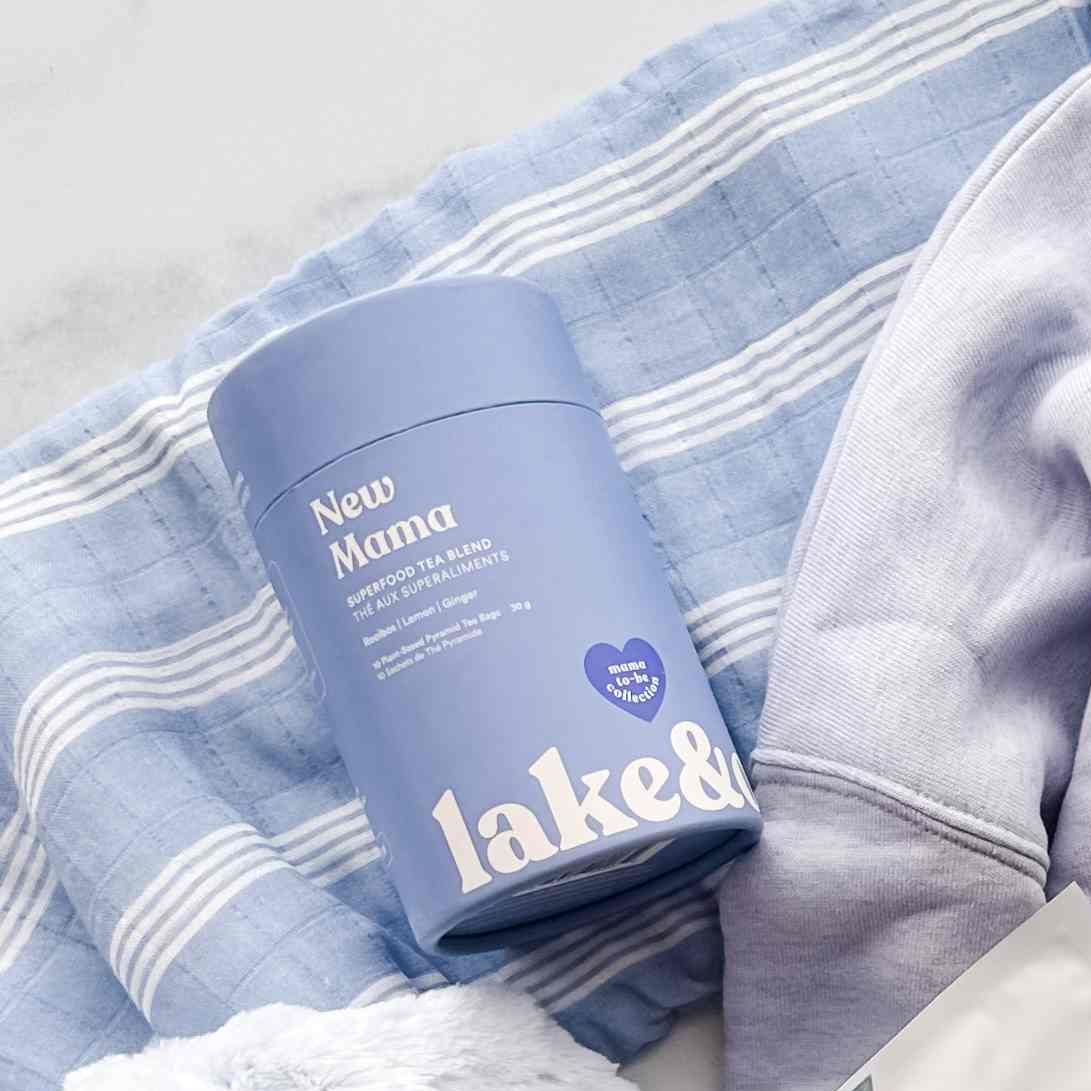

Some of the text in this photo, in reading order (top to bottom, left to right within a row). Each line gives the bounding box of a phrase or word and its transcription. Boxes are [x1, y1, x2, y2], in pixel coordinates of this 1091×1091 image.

[310, 475, 395, 536] New
[328, 504, 458, 580] Mama
[347, 538, 492, 608] SUPERFOOD TEA BLEND
[353, 550, 510, 622] THÉ AUX SUPERALIMENTS
[401, 606, 436, 627] Lemon
[442, 589, 478, 609] Ginger
[606, 676, 660, 703] collection
[607, 660, 647, 675] mama
[615, 671, 649, 687] to-be
